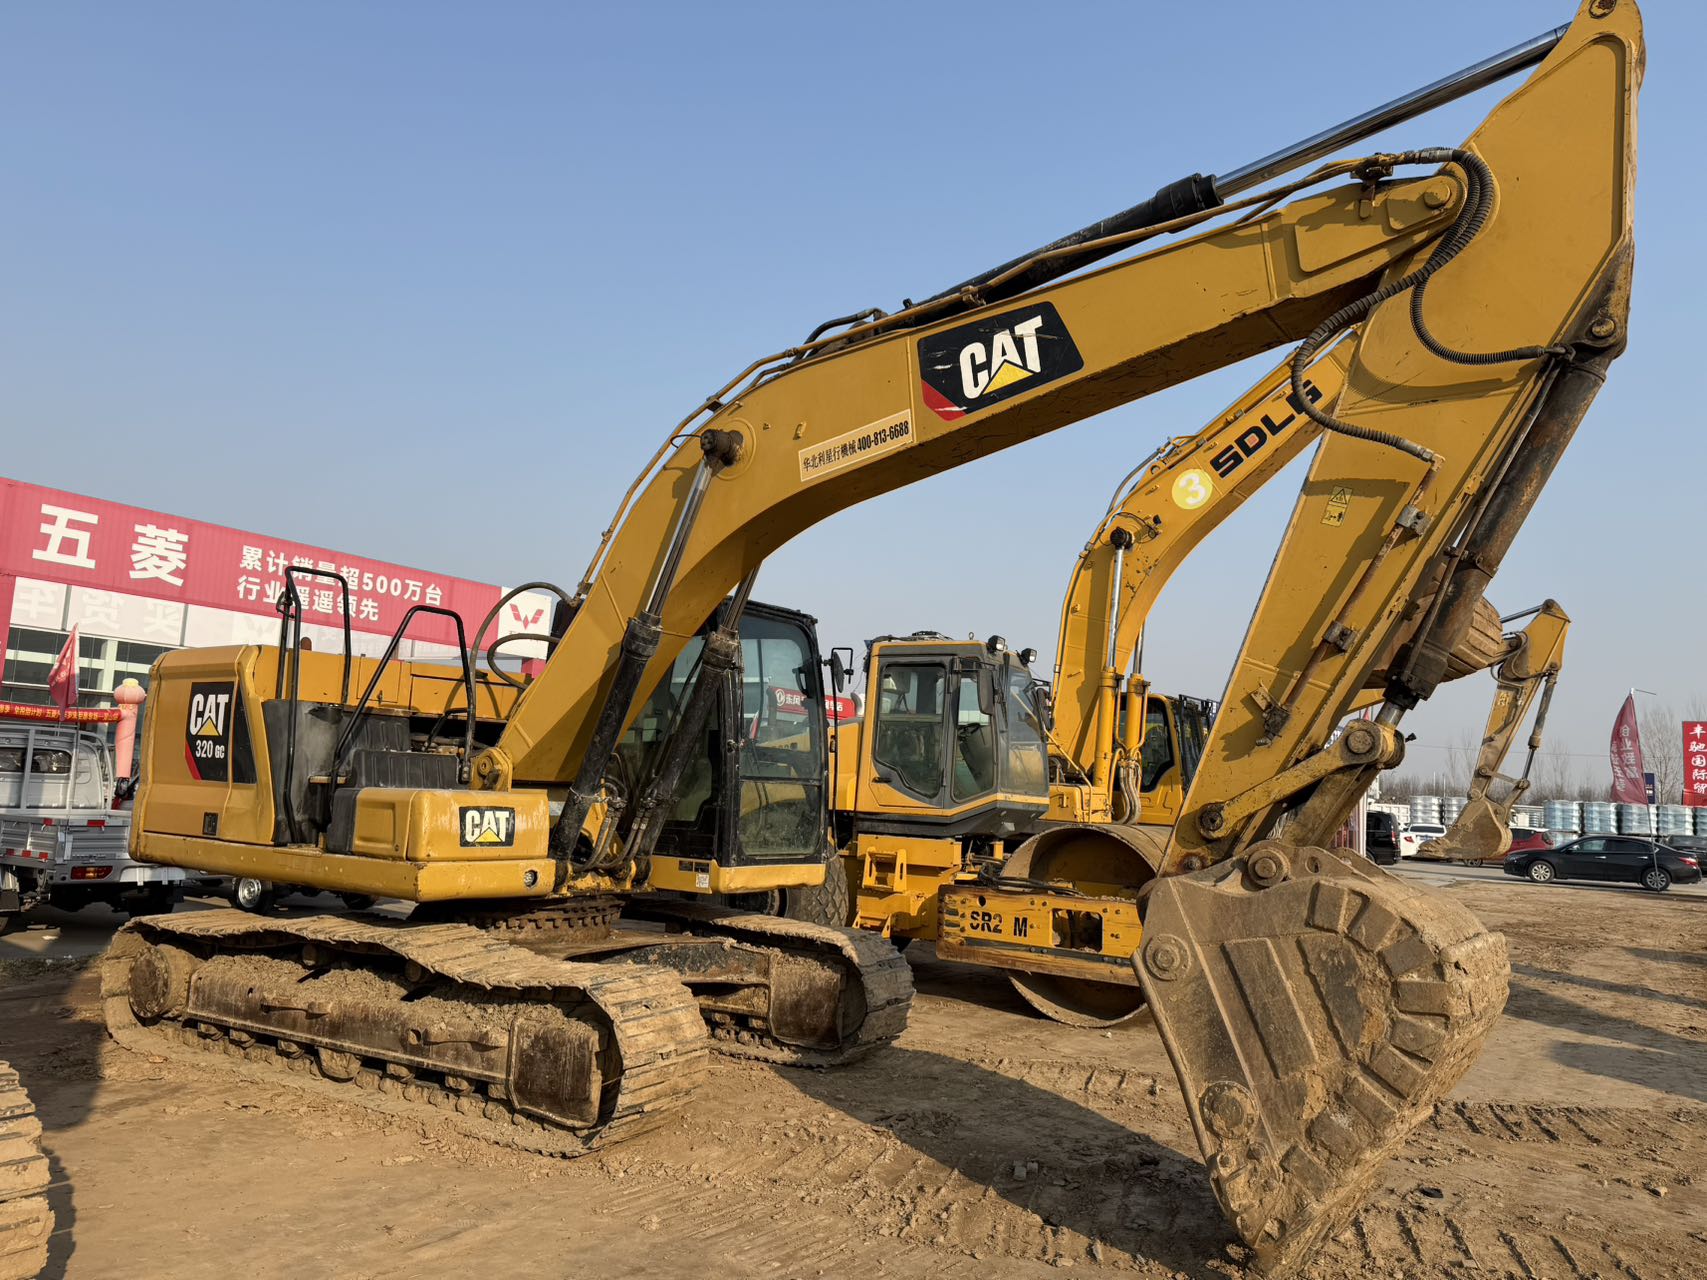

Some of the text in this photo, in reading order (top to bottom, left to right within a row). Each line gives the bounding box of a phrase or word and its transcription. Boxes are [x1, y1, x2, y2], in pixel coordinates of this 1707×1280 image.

[959, 315, 1043, 399] CAT
[857, 420, 909, 453] 400-813-6688
[1210, 379, 1323, 479] SDLG
[1178, 474, 1207, 505] 3
[32, 503, 189, 587] 五菱
[240, 545, 443, 606] 累计销量超500万台
[189, 693, 229, 736] CAT
[195, 740, 225, 759] 320 GC
[465, 810, 510, 842] CAT
[1013, 917, 1028, 938] M
